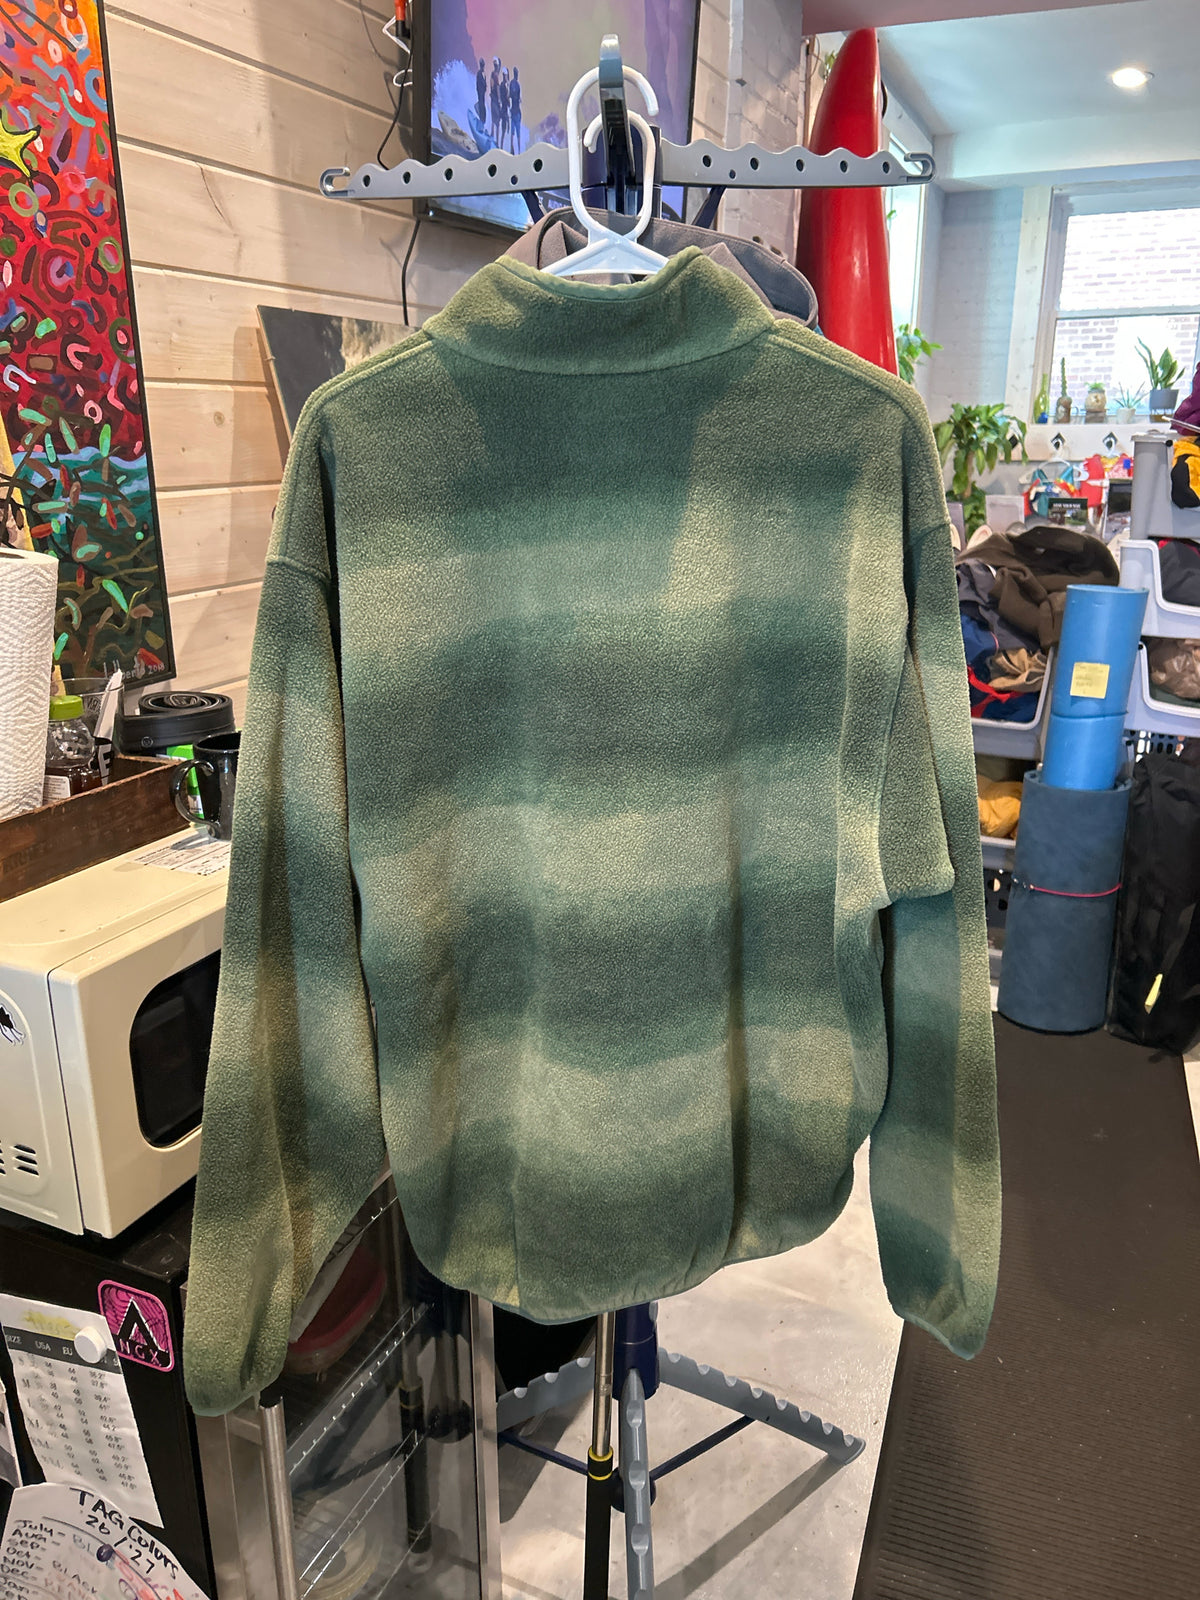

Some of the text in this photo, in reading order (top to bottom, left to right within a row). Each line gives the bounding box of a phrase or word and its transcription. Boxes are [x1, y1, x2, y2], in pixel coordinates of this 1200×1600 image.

[34, 1340, 51, 1352] USA
[62, 1346, 73, 1356] EU
[14, 1519, 54, 1537] July
[69, 1487, 179, 1580] TAG Colors
